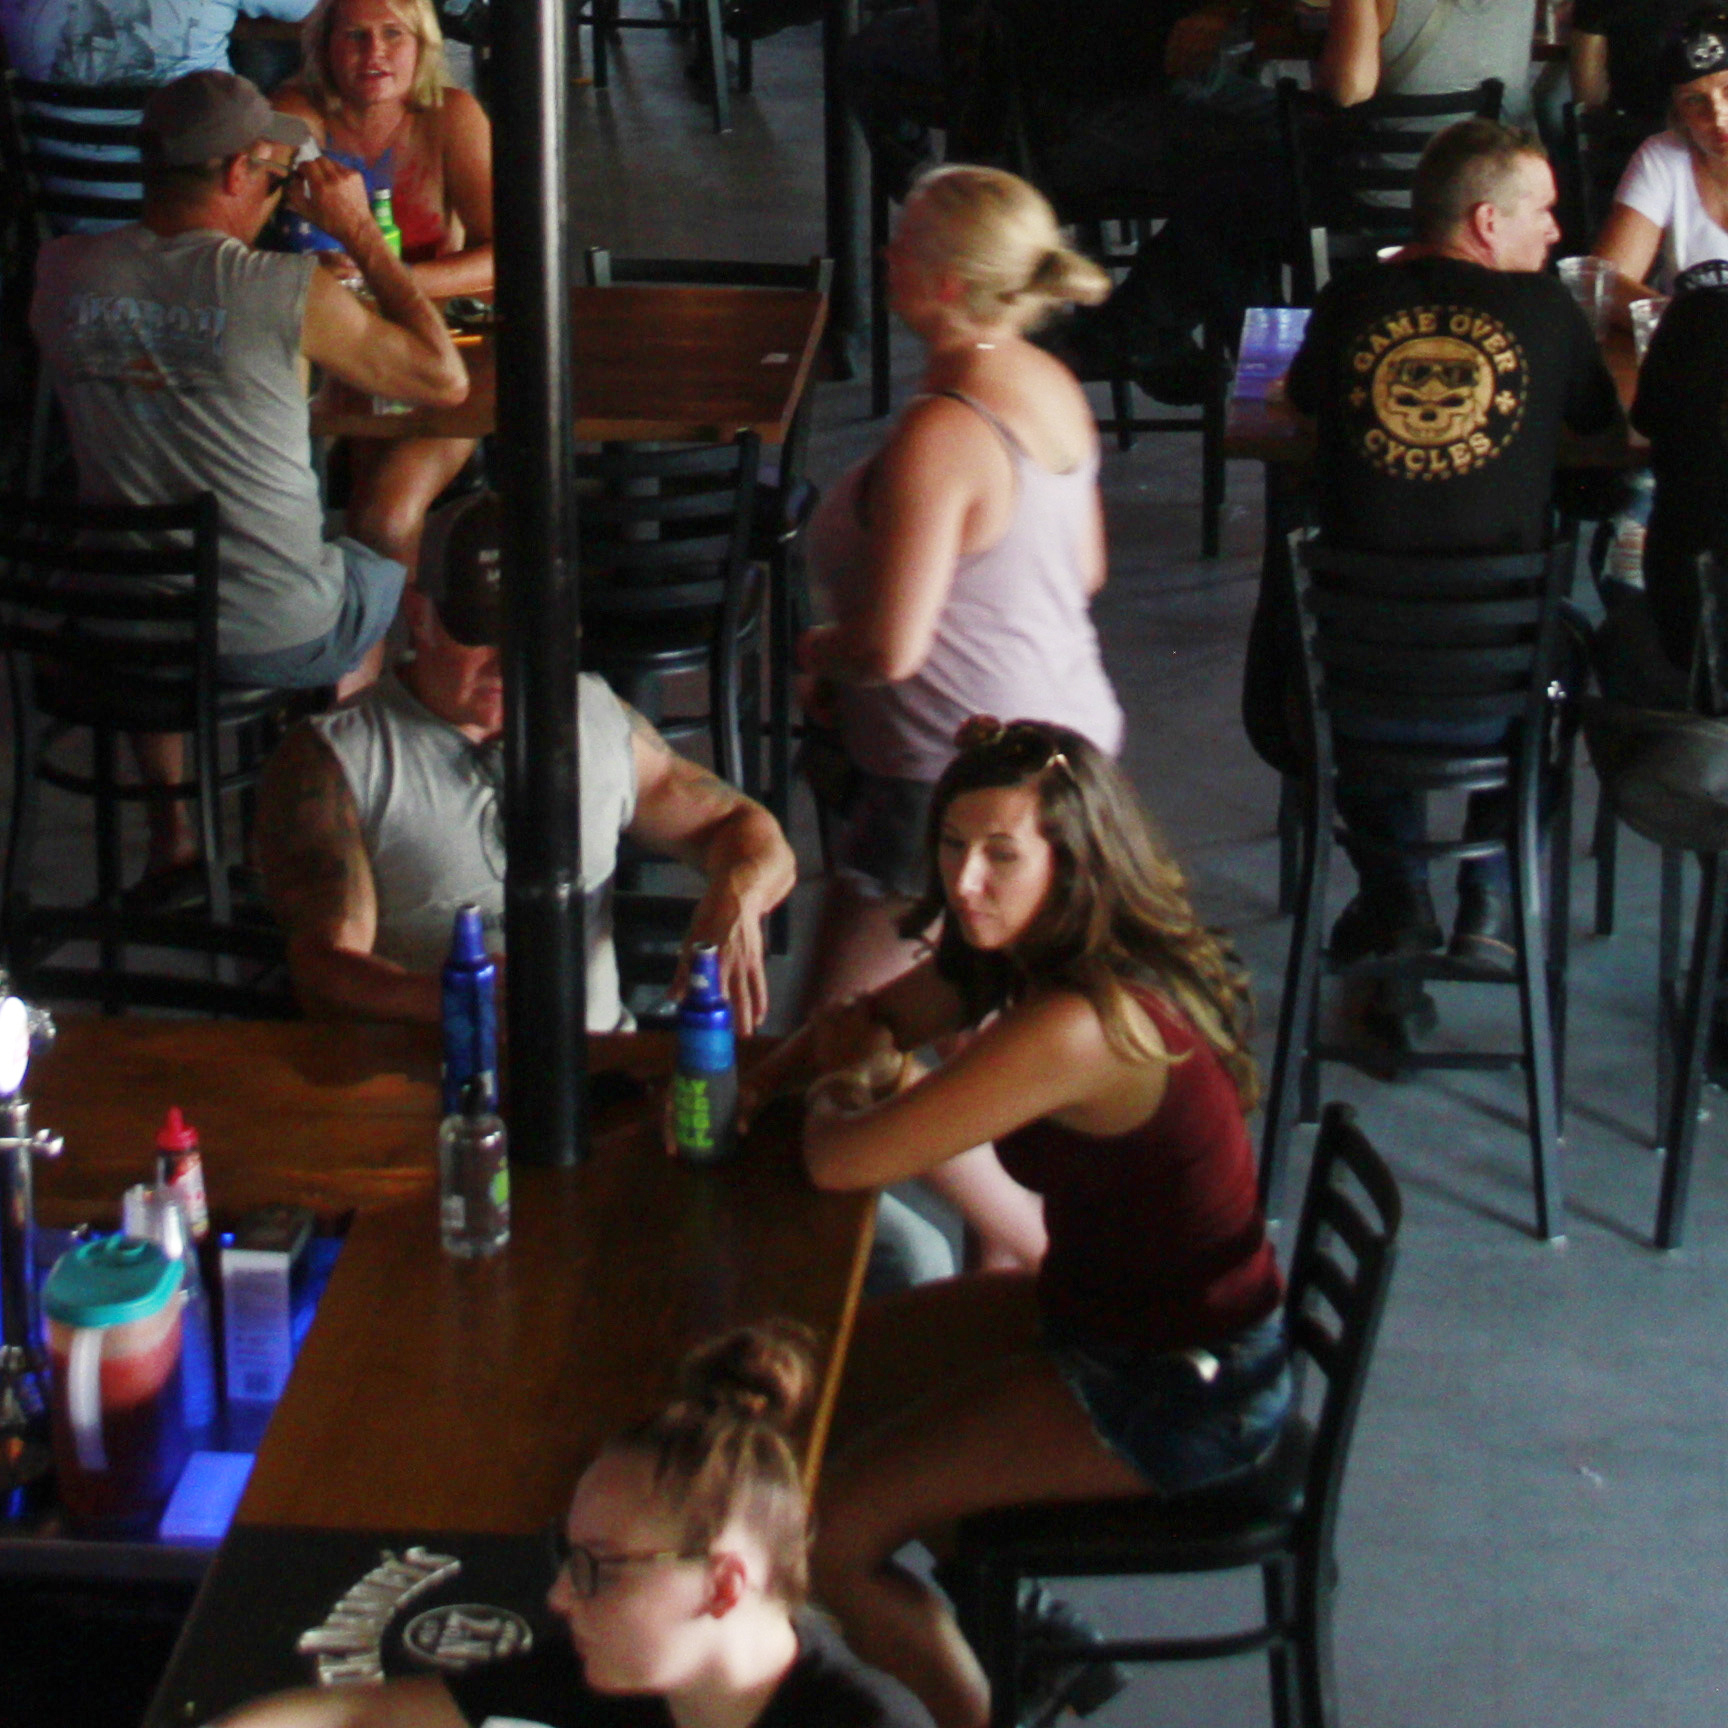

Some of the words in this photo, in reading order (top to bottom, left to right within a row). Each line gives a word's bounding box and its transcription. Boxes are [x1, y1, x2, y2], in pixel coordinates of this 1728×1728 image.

[1353, 312, 1438, 374] GAME
[1448, 314, 1519, 374] OVER
[1364, 428, 1492, 472] CYCLES
